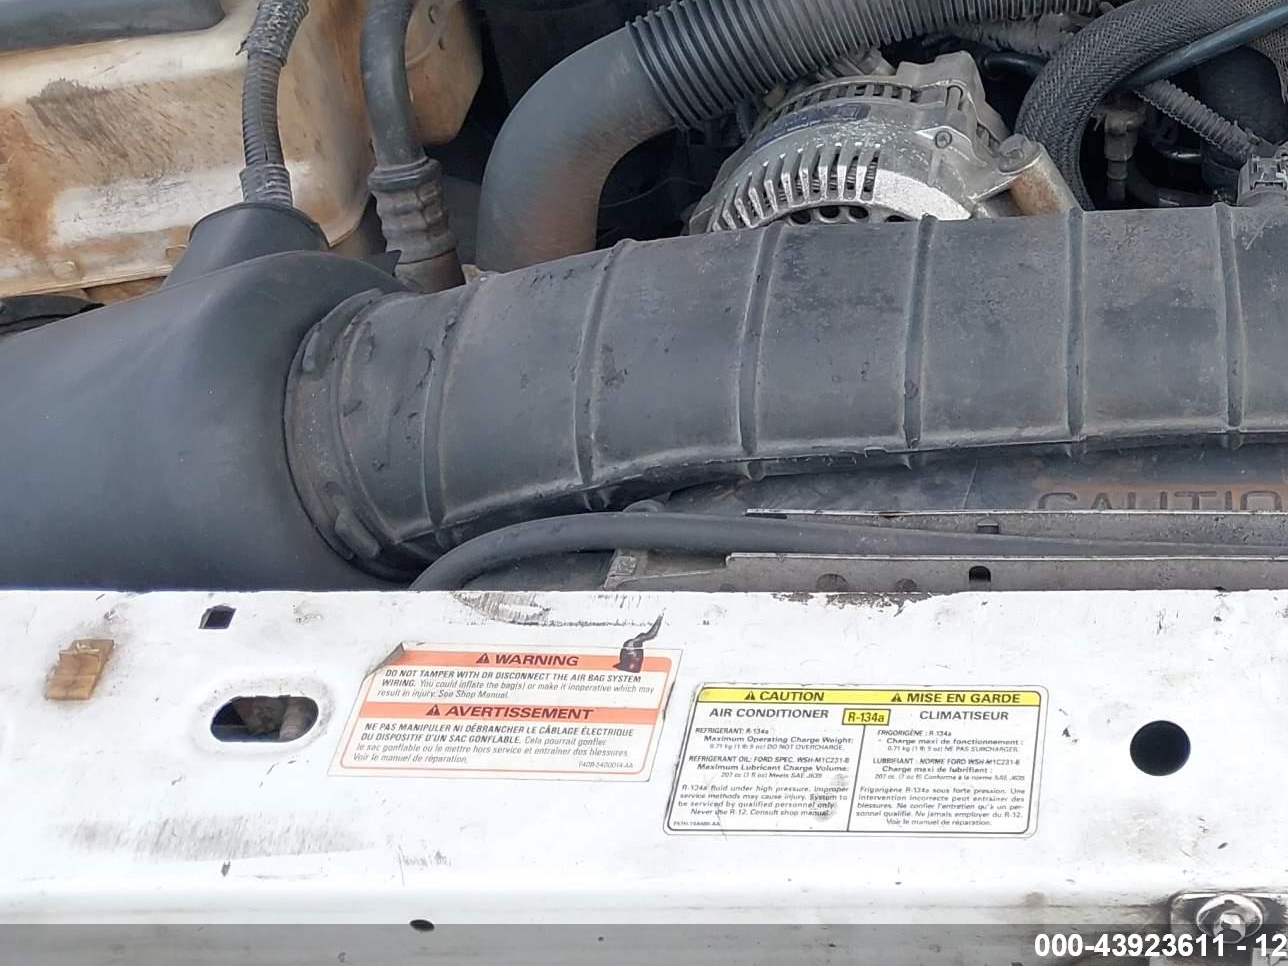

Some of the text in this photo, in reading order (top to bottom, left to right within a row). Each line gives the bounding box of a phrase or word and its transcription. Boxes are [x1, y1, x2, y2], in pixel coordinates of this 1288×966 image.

[495, 654, 579, 666] WARNING
[420, 670, 454, 678] TAMPER
[457, 671, 479, 679] WITH
[482, 671, 493, 679] OR
[496, 672, 550, 680] DISCONNECT
[607, 675, 641, 683] SYSTEM
[382, 679, 416, 687] WIRING.
[459, 681, 484, 689] inflate
[501, 682, 526, 690] bag(s)
[568, 684, 612, 692] inoperative
[614, 685, 637, 693] which
[412, 690, 436, 699] injury.
[438, 690, 453, 698] See
[455, 690, 475, 699] Shop
[759, 691, 824, 701] CAUTION
[907, 693, 1021, 703] MISE EN GARDE
[445, 706, 593, 720] AVERTISSEMENT
[709, 708, 829, 718] AIR CONDITIONER
[848, 711, 884, 723] R-134a
[919, 711, 1009, 720] CLIMATISEUR
[399, 724, 451, 732] MANIPULER
[465, 724, 524, 734] DÉBRANCHER
[539, 726, 578, 735] CÂBLAGE
[581, 726, 633, 736] ÉLECTRIQUE
[361, 733, 373, 741] DU
[425, 734, 447, 742] D'UN
[469, 735, 521, 744] GONFLABLE.
[525, 737, 542, 745] Cela
[544, 737, 576, 747] pourrait
[578, 738, 606, 747] gonfler
[747, 736, 788, 744] Operating
[383, 744, 420, 753] gonflable
[445, 745, 470, 753] mettre
[493, 746, 522, 754] service
[573, 748, 587, 756] des
[589, 749, 628, 757] blessures
[381, 754, 410, 762] manuel
[814, 786, 848, 794] Improper
[738, 801, 773, 810] qualified
[775, 802, 815, 810] personnel
[780, 810, 799, 818] shop
[927, 811, 952, 819] jamais
